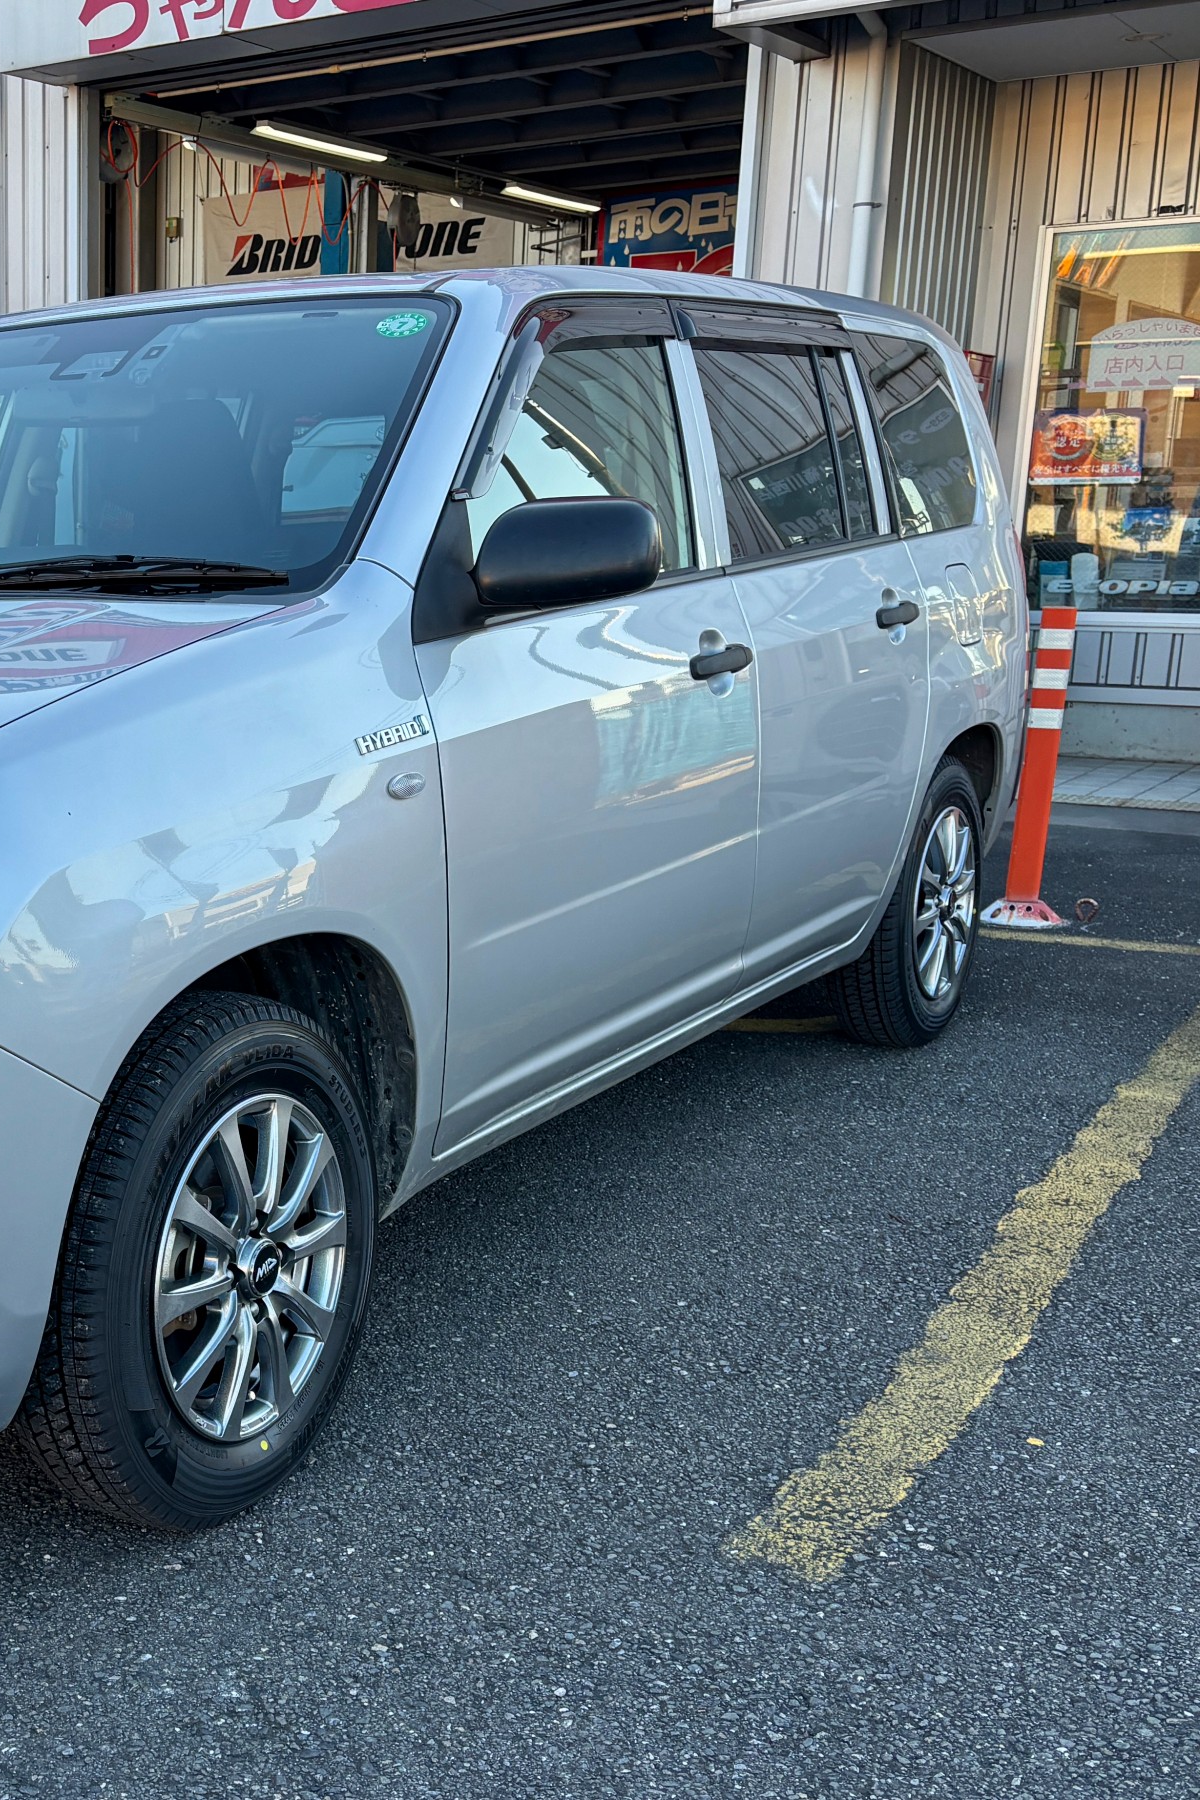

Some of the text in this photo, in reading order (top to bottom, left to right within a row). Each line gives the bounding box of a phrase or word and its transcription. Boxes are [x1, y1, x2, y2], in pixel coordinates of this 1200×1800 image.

[608, 191, 739, 243] 雨の日
[1104, 355, 1184, 374] 店内入口
[356, 721, 423, 755] HYBRID
[328, 1073, 366, 1160] STUDLESS
